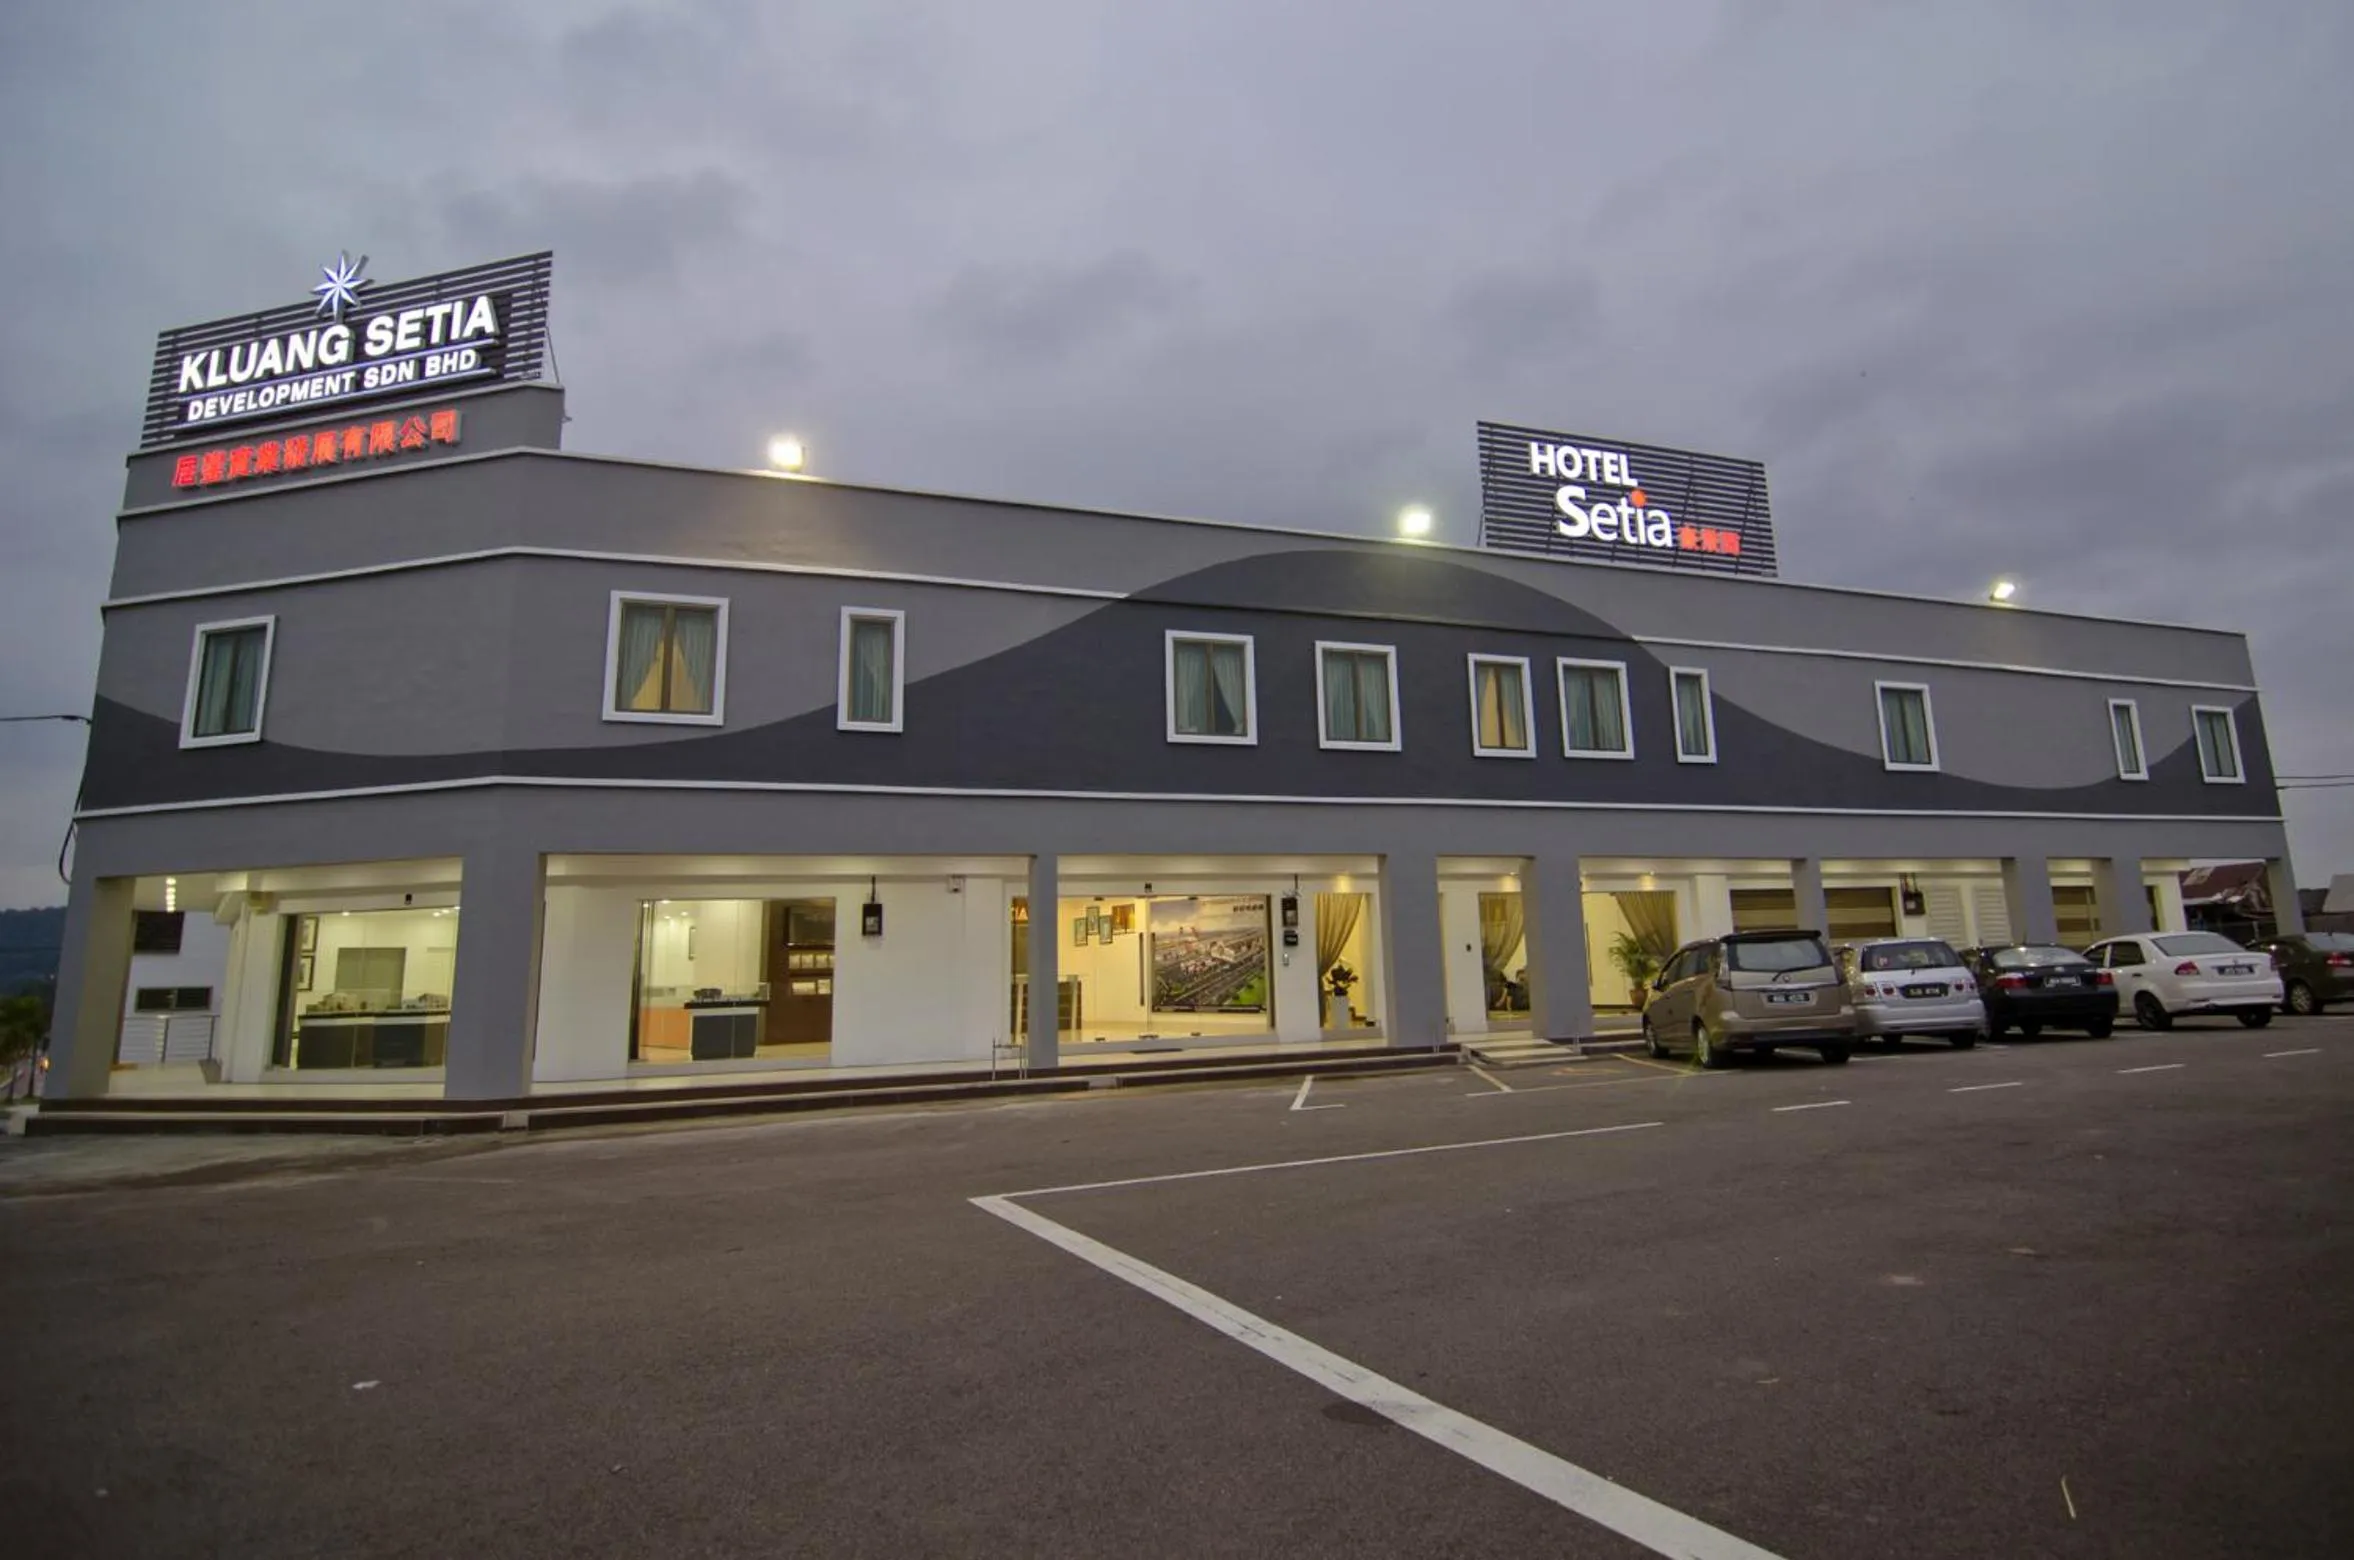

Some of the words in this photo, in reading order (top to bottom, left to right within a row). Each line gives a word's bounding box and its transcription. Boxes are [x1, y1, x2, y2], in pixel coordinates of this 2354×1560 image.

[178, 324, 351, 394] KLUANG
[364, 295, 496, 357] SETIA
[187, 371, 356, 422] DEVELOPMENT
[363, 358, 416, 389] SDN
[424, 348, 478, 378] BHD
[1528, 441, 1638, 487] HOTEL
[1555, 485, 1674, 548] Setia
